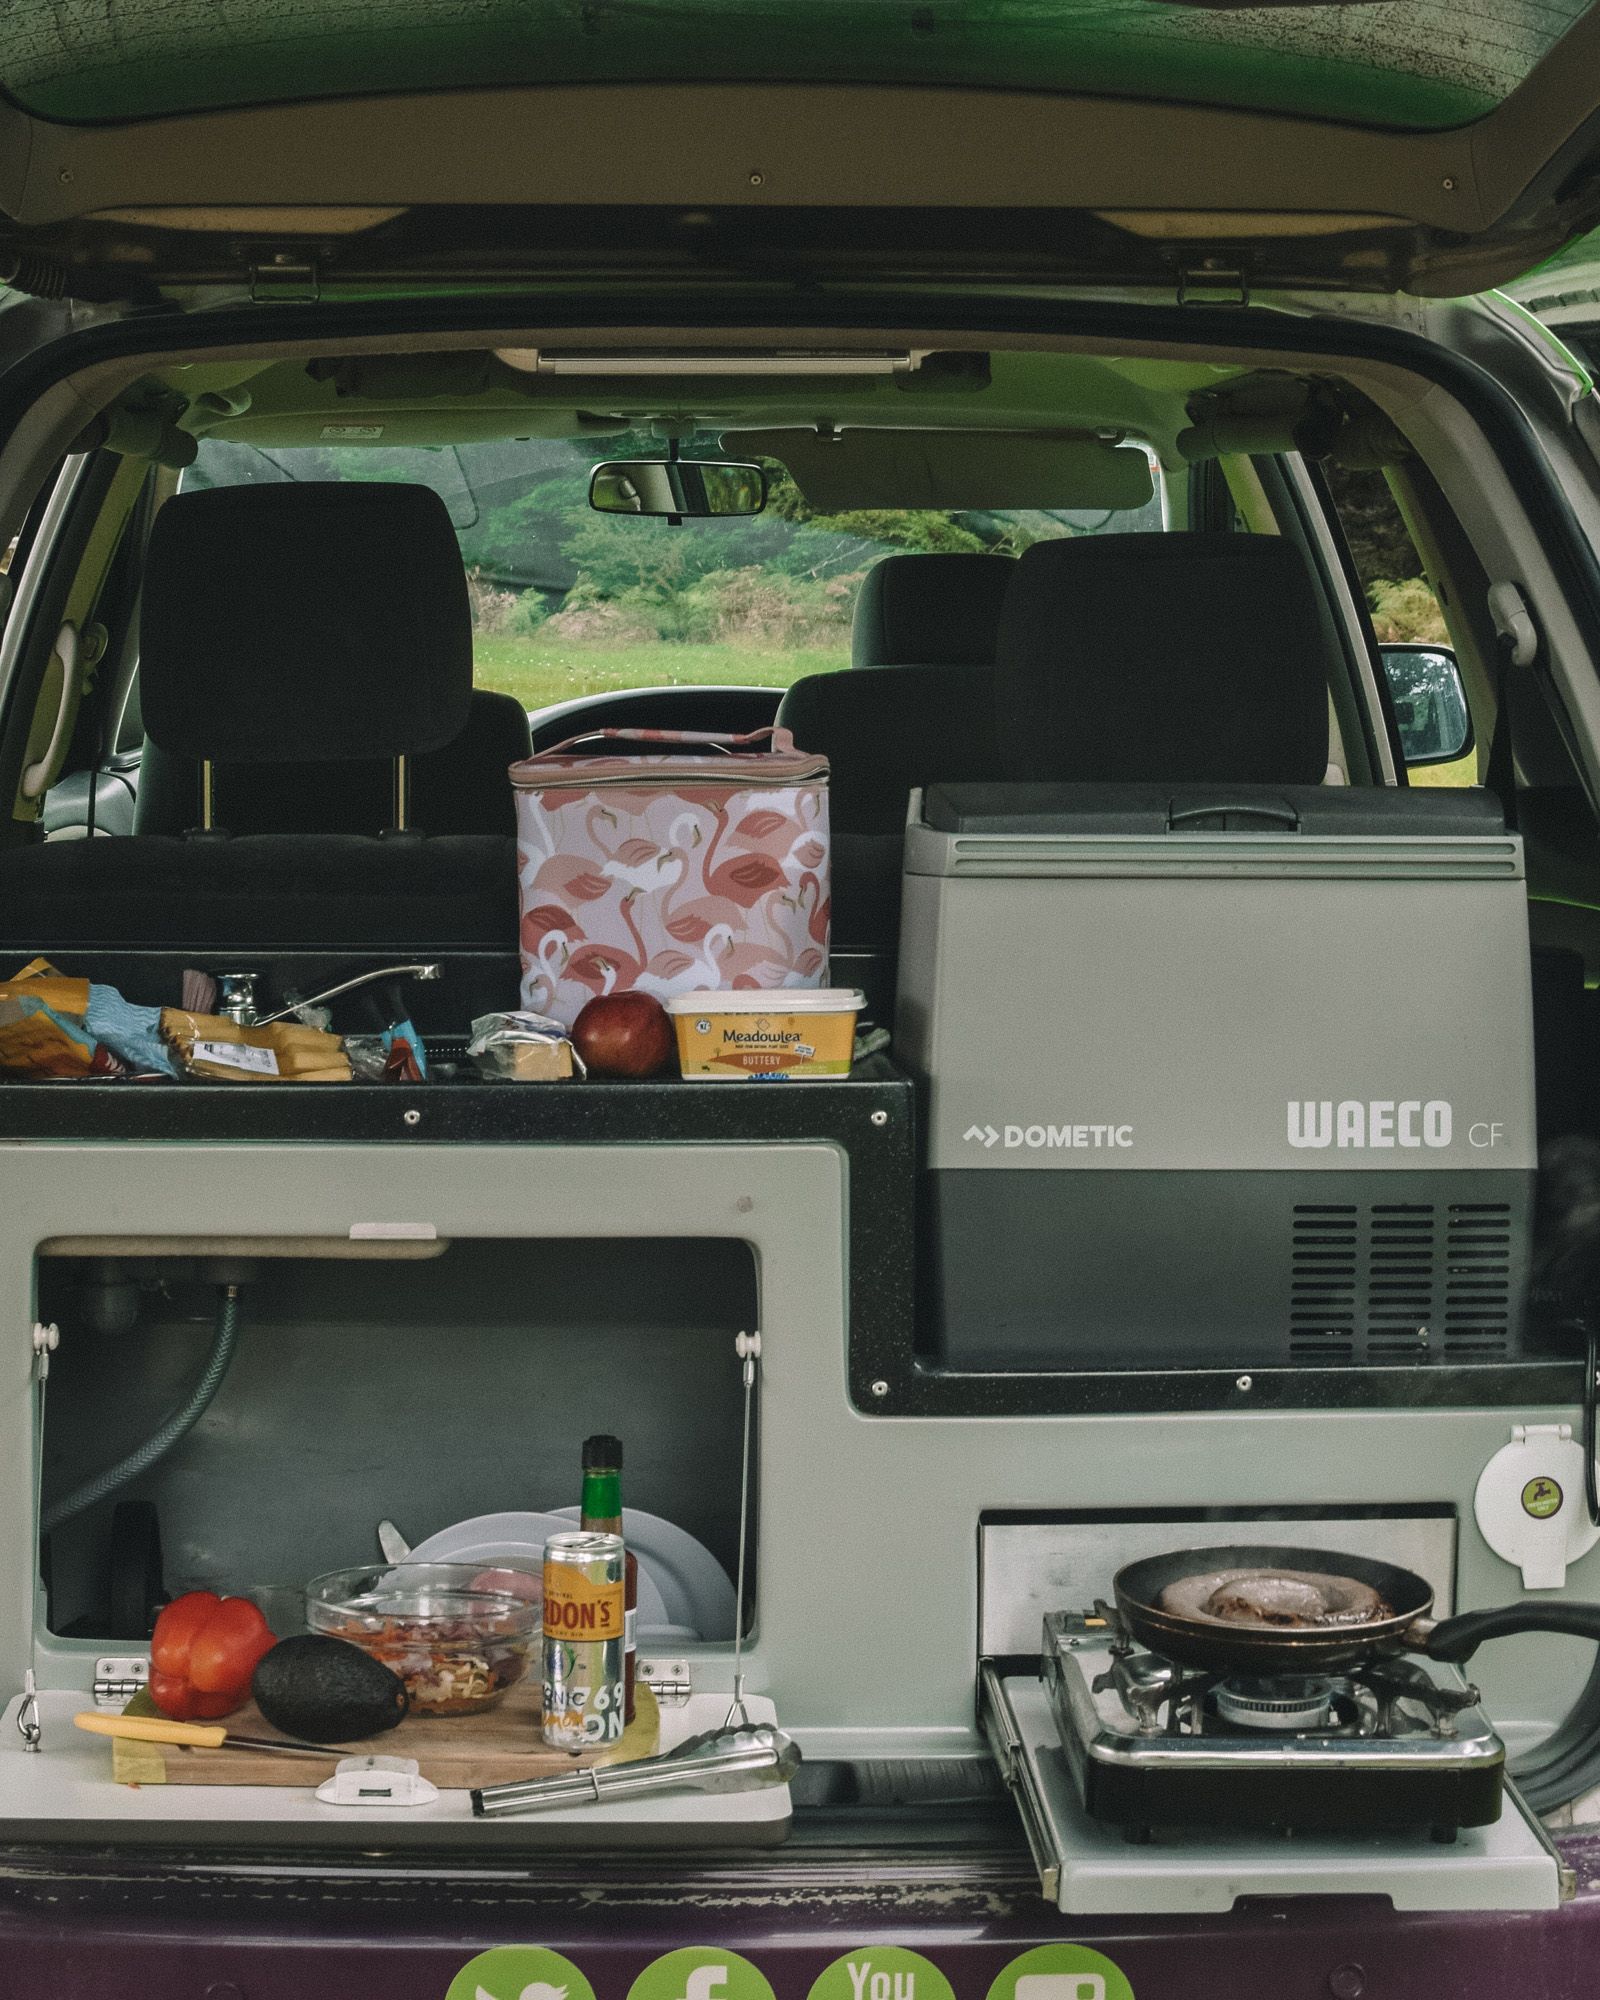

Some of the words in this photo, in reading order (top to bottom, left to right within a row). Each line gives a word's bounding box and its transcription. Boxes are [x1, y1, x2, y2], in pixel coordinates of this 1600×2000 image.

[723, 1029, 801, 1044] Meadowlea
[743, 1055, 781, 1065] BUTTERY
[1287, 1100, 1453, 1148] WAECO
[1468, 1122, 1505, 1149] CF
[1004, 1125, 1134, 1148] DOMETIC
[847, 1962, 914, 2000] You
